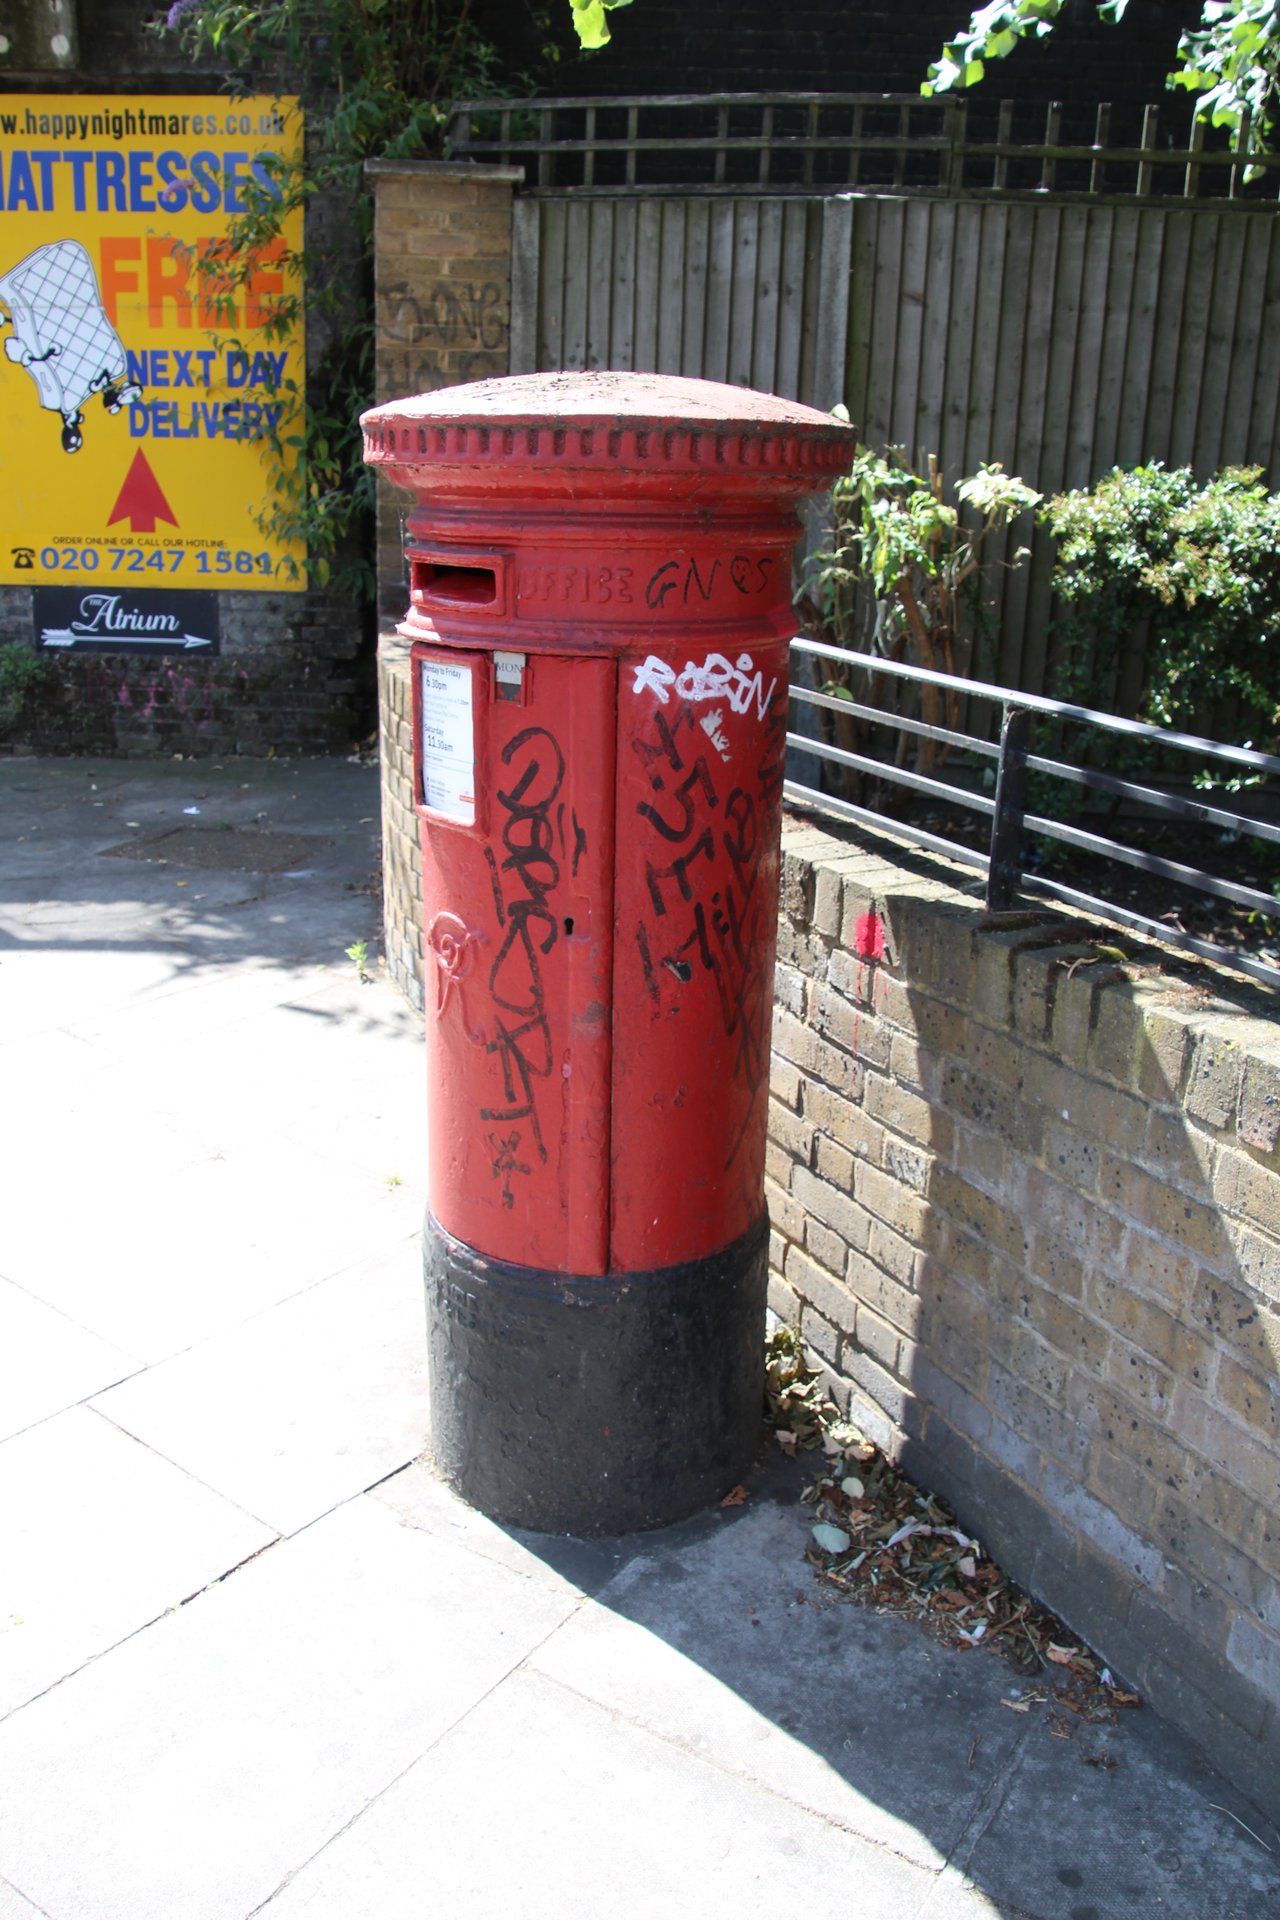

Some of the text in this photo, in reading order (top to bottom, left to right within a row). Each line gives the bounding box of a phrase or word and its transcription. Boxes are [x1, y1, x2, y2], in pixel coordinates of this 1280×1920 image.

[0, 150, 283, 213] ATTRESSES
[100, 237, 287, 329] FREE
[126, 350, 288, 389] NEXT DAY
[129, 401, 282, 439] DELIVERY
[40, 547, 273, 574] 020 7247 1581
[52, 536, 82, 545] ORDER
[85, 537, 117, 546] ONLINE
[120, 537, 134, 546] OR
[137, 538, 160, 547] CALL
[163, 538, 184, 547] OUR
[72, 594, 180, 632] Atrium
[495, 662, 522, 673] MON
